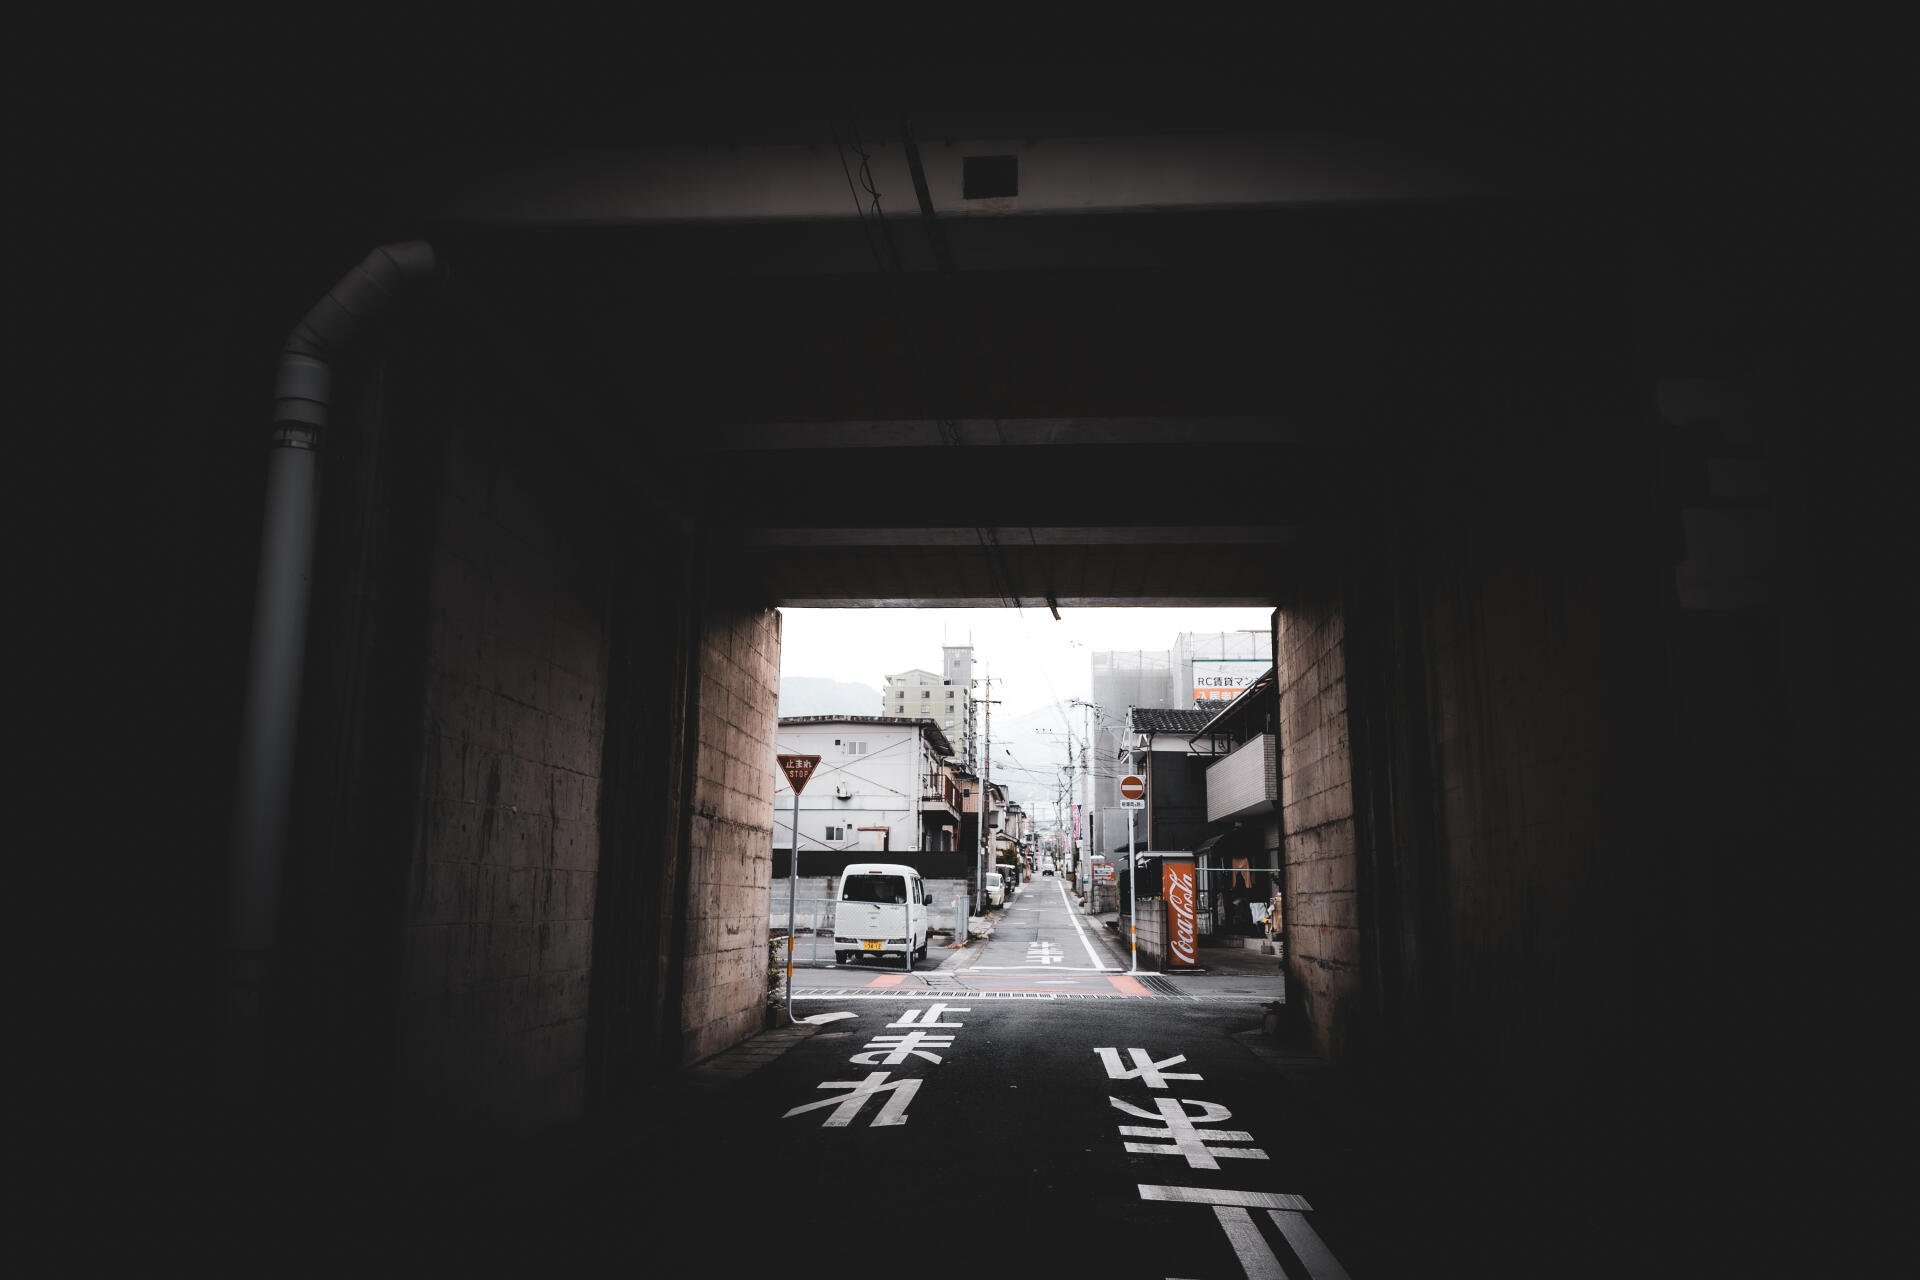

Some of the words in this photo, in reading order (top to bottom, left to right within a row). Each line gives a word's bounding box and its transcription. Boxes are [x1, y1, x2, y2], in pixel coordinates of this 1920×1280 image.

[786, 760, 812, 768] 止まれ
[1169, 867, 1195, 964] Coca-Cola
[782, 1003, 971, 1127] 止まれ
